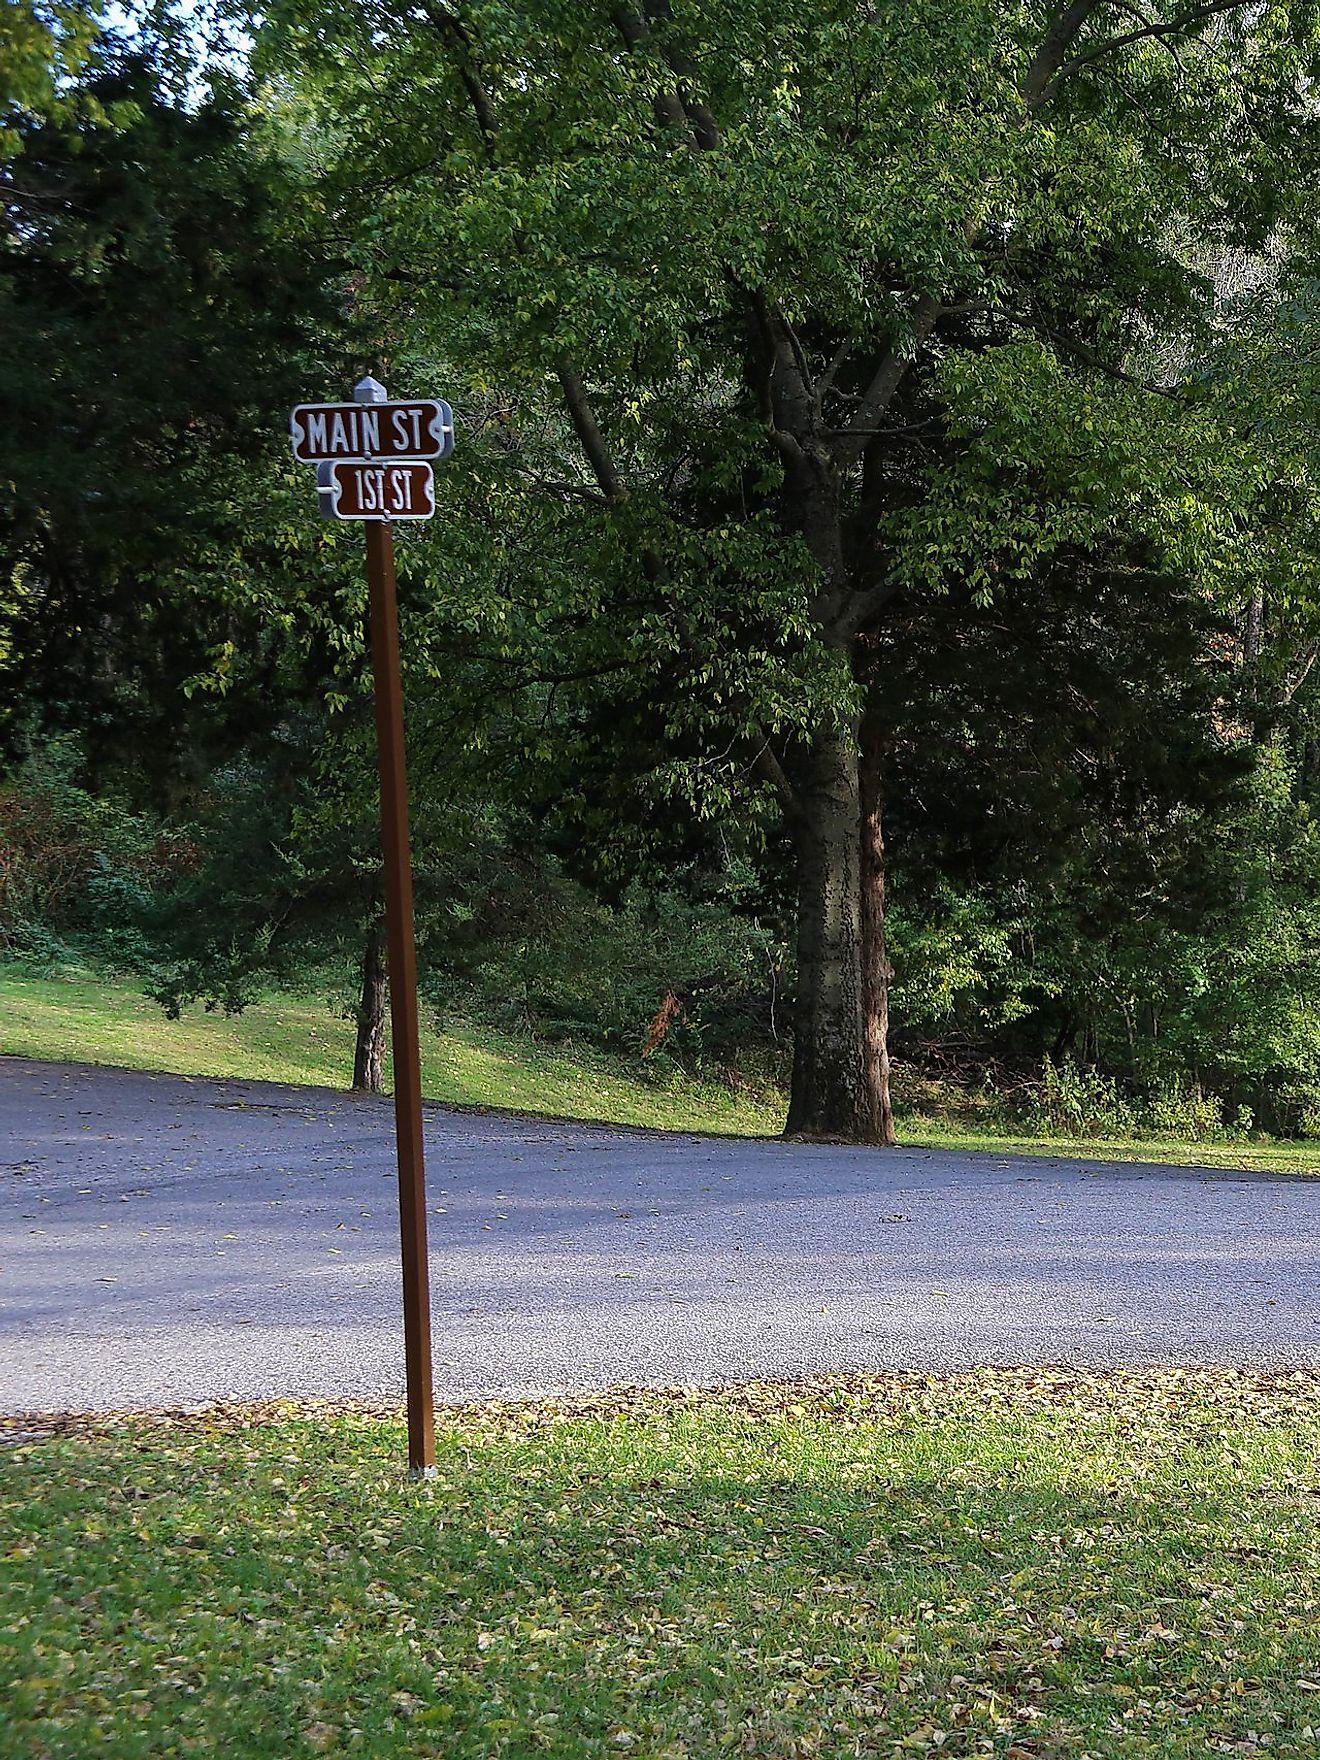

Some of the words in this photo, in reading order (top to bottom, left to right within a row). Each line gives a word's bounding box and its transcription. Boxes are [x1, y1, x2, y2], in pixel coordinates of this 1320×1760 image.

[307, 411, 380, 453] MAIN
[391, 409, 423, 451] ST
[354, 470, 385, 510] 1ST
[390, 470, 412, 510] ST
